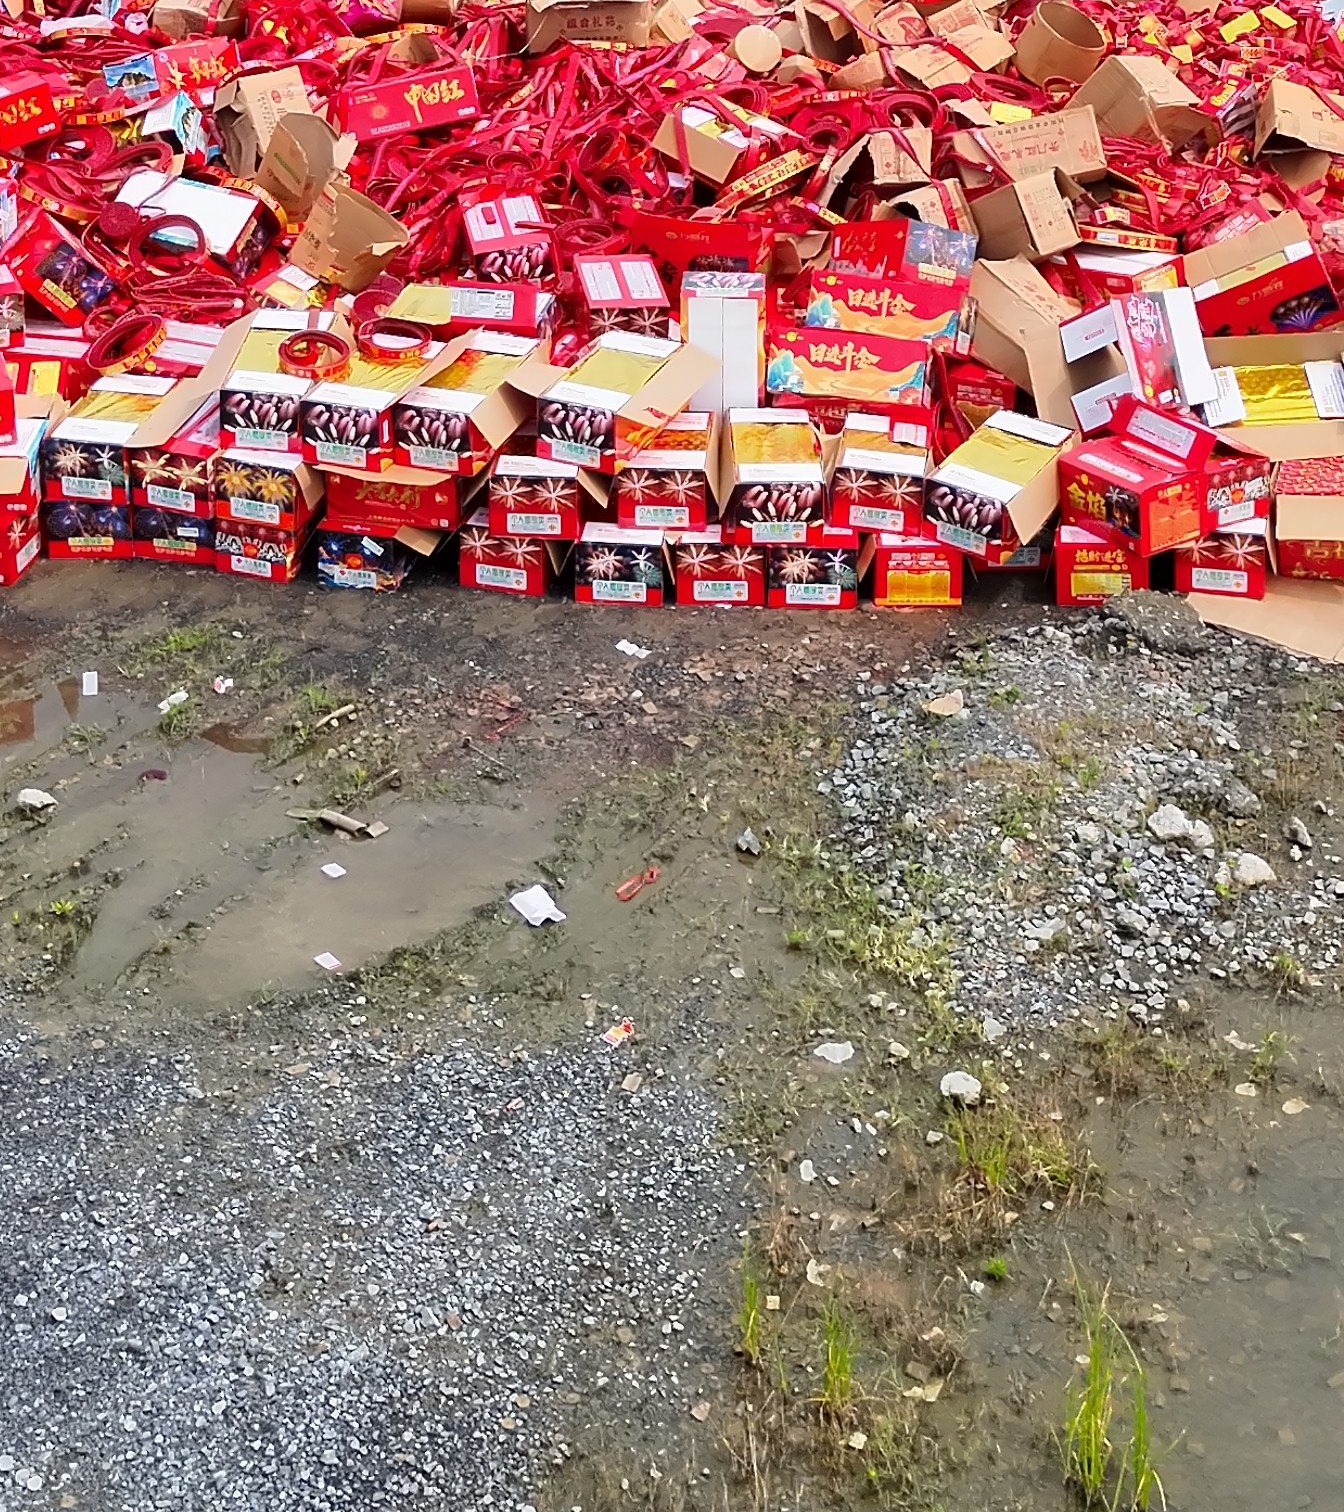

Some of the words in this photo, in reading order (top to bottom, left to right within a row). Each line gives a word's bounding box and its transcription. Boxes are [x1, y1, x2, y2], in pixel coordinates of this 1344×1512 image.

[566, 14, 616, 30] 组合礼花
[404, 77, 466, 124] 中国红
[846, 285, 918, 320] 日进斗金
[808, 340, 882, 374] 日进斗金
